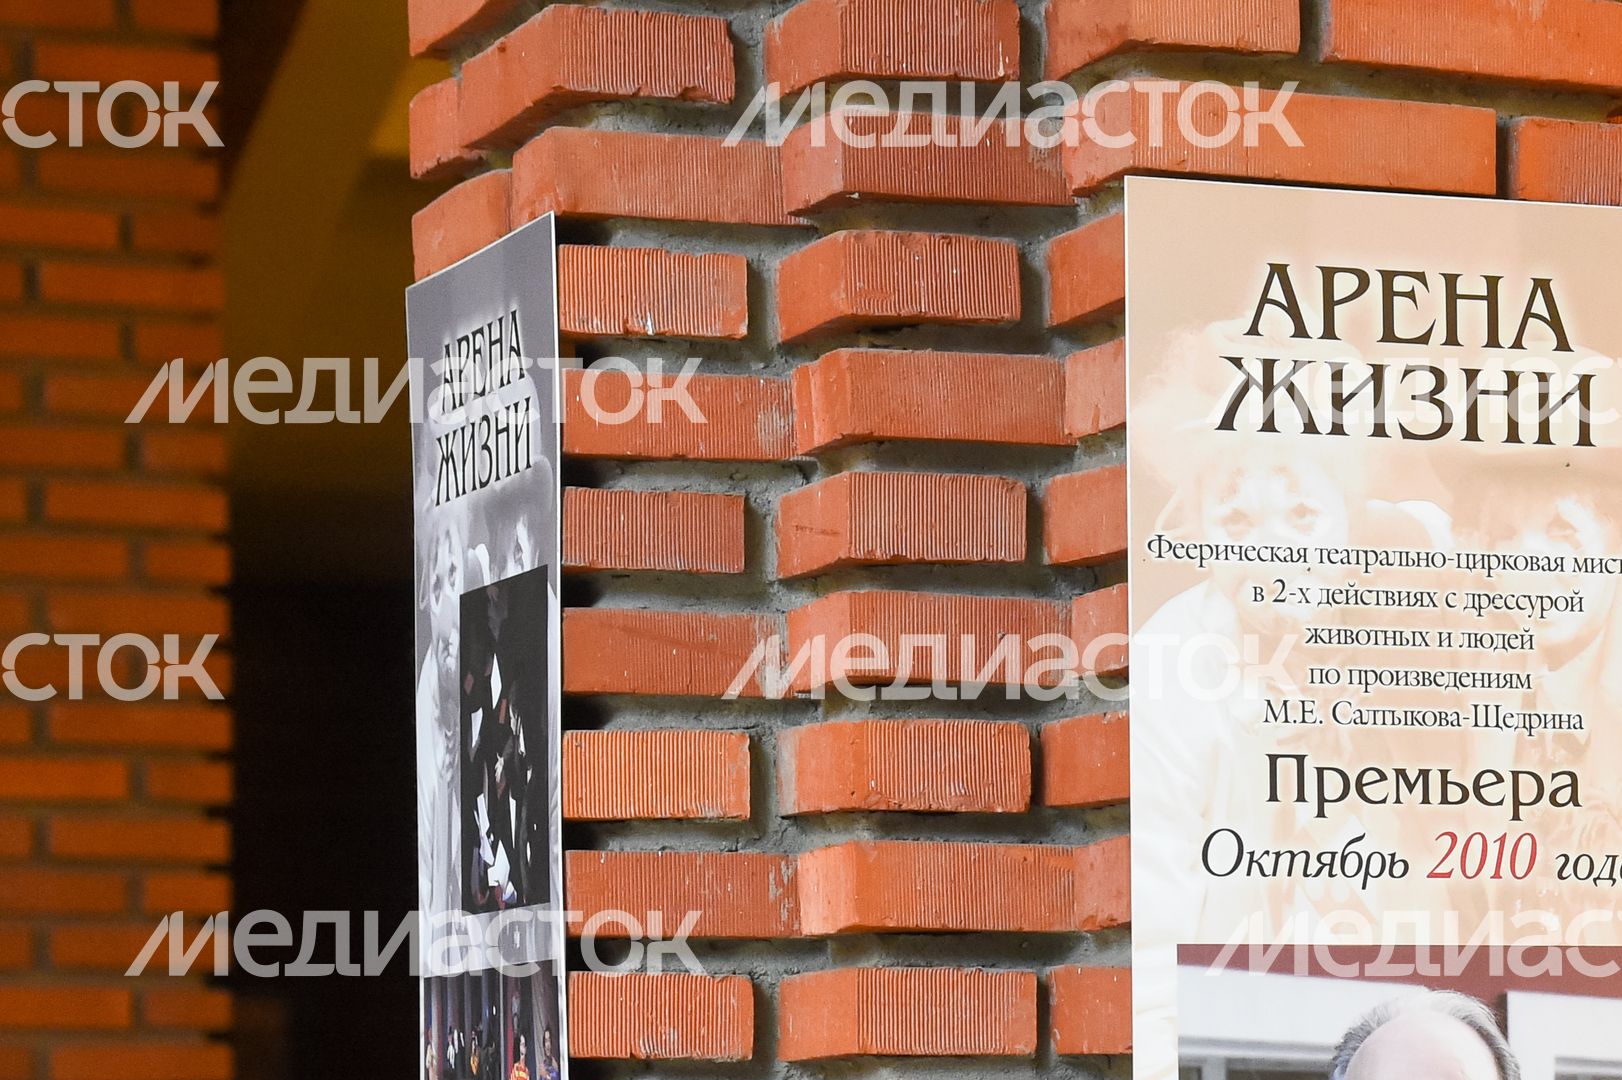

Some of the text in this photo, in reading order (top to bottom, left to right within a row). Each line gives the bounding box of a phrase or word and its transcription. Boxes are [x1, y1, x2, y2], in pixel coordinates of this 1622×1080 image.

[1242, 262, 1575, 353] АРЕНА
[441, 309, 525, 415] АРЕНА
[1214, 355, 1598, 448] ЖИЗНИ
[435, 396, 532, 507] ЖИЗНИ
[1147, 534, 1308, 568] Феерическая
[1314, 547, 1565, 577] театрально-цирковая
[1252, 578, 1584, 619] в 2-х действиях с дрессурой
[1305, 627, 1534, 652] животных и людей
[1309, 668, 1532, 694] по произведениям
[1263, 699, 1585, 733] М.Е. Салтыкова-Щедрина
[1265, 753, 1583, 822] Премьера
[1201, 828, 1410, 891] Октябрь
[1426, 831, 1538, 880] 2010
